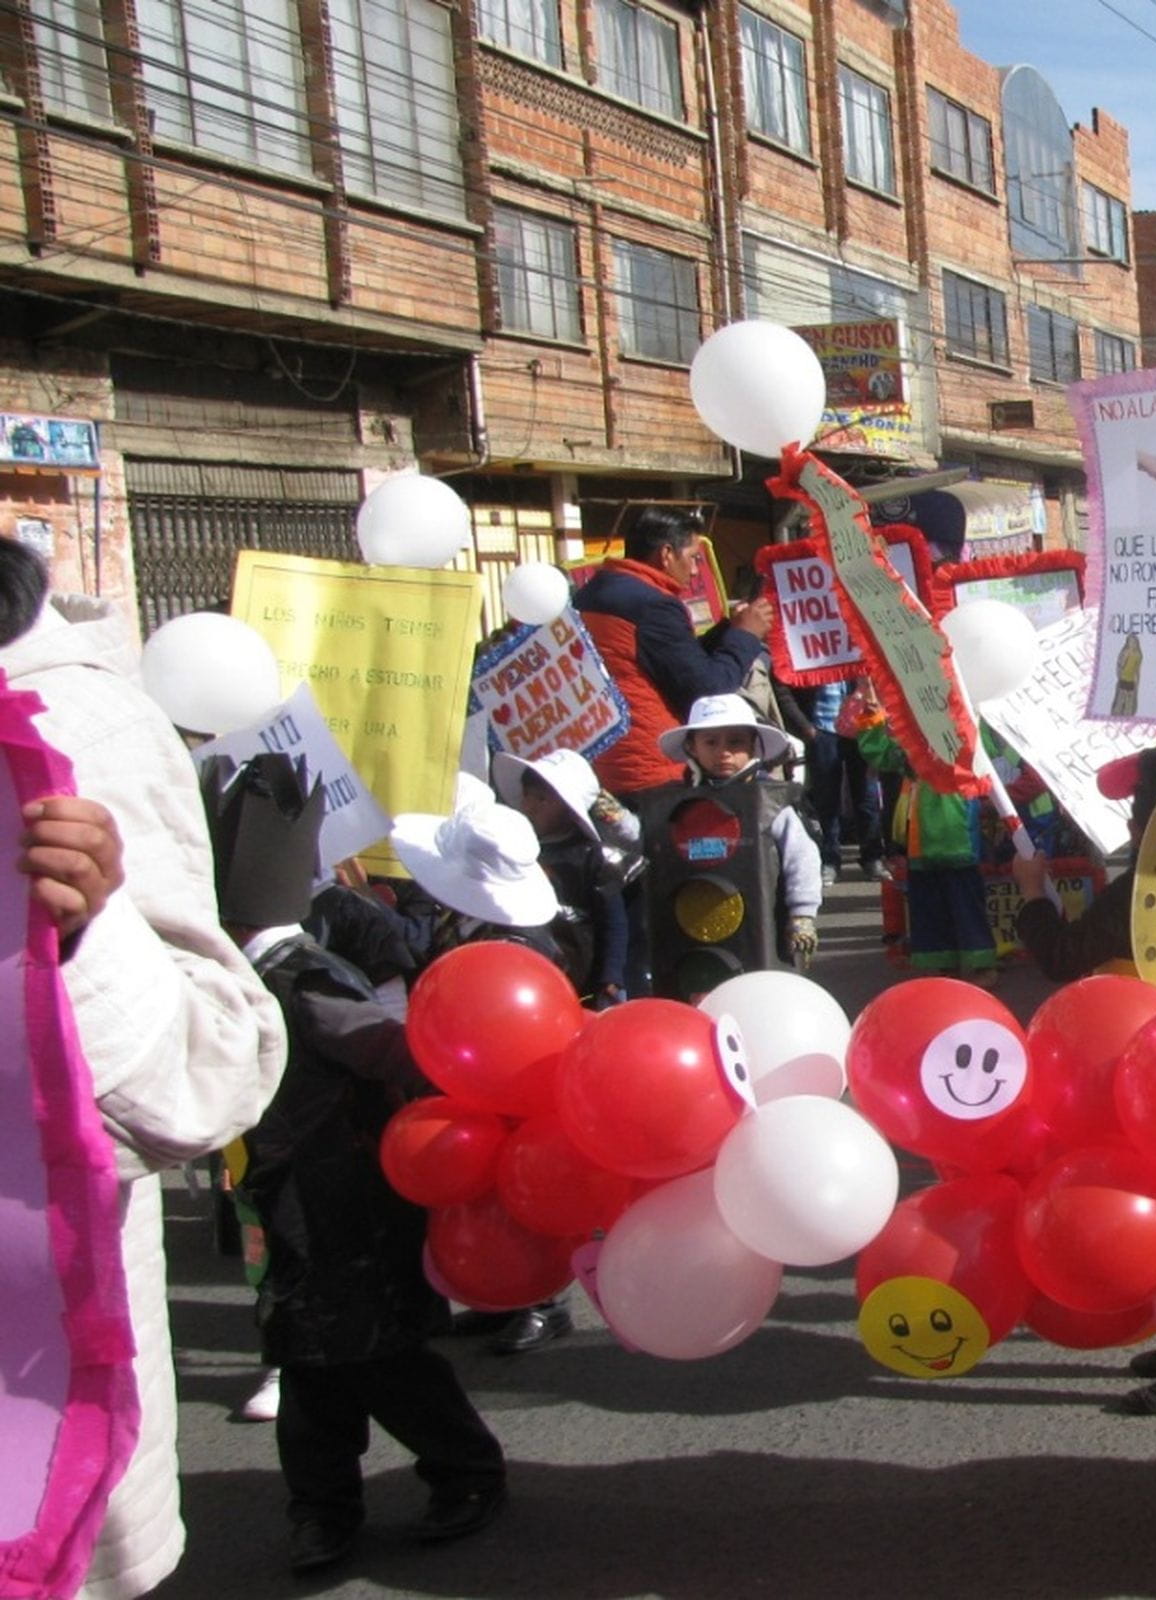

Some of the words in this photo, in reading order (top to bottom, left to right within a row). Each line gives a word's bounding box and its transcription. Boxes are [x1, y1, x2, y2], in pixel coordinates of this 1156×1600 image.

[832, 321, 895, 350] GUSTO
[1098, 399, 1124, 421] NO
[1114, 535, 1144, 557] QUE
[787, 565, 825, 593] NO
[1110, 563, 1128, 583] NO
[782, 595, 840, 626] VIOL
[277, 658, 340, 682] ERECHO
[506, 697, 571, 753] FUERA
[571, 675, 597, 707] LA
